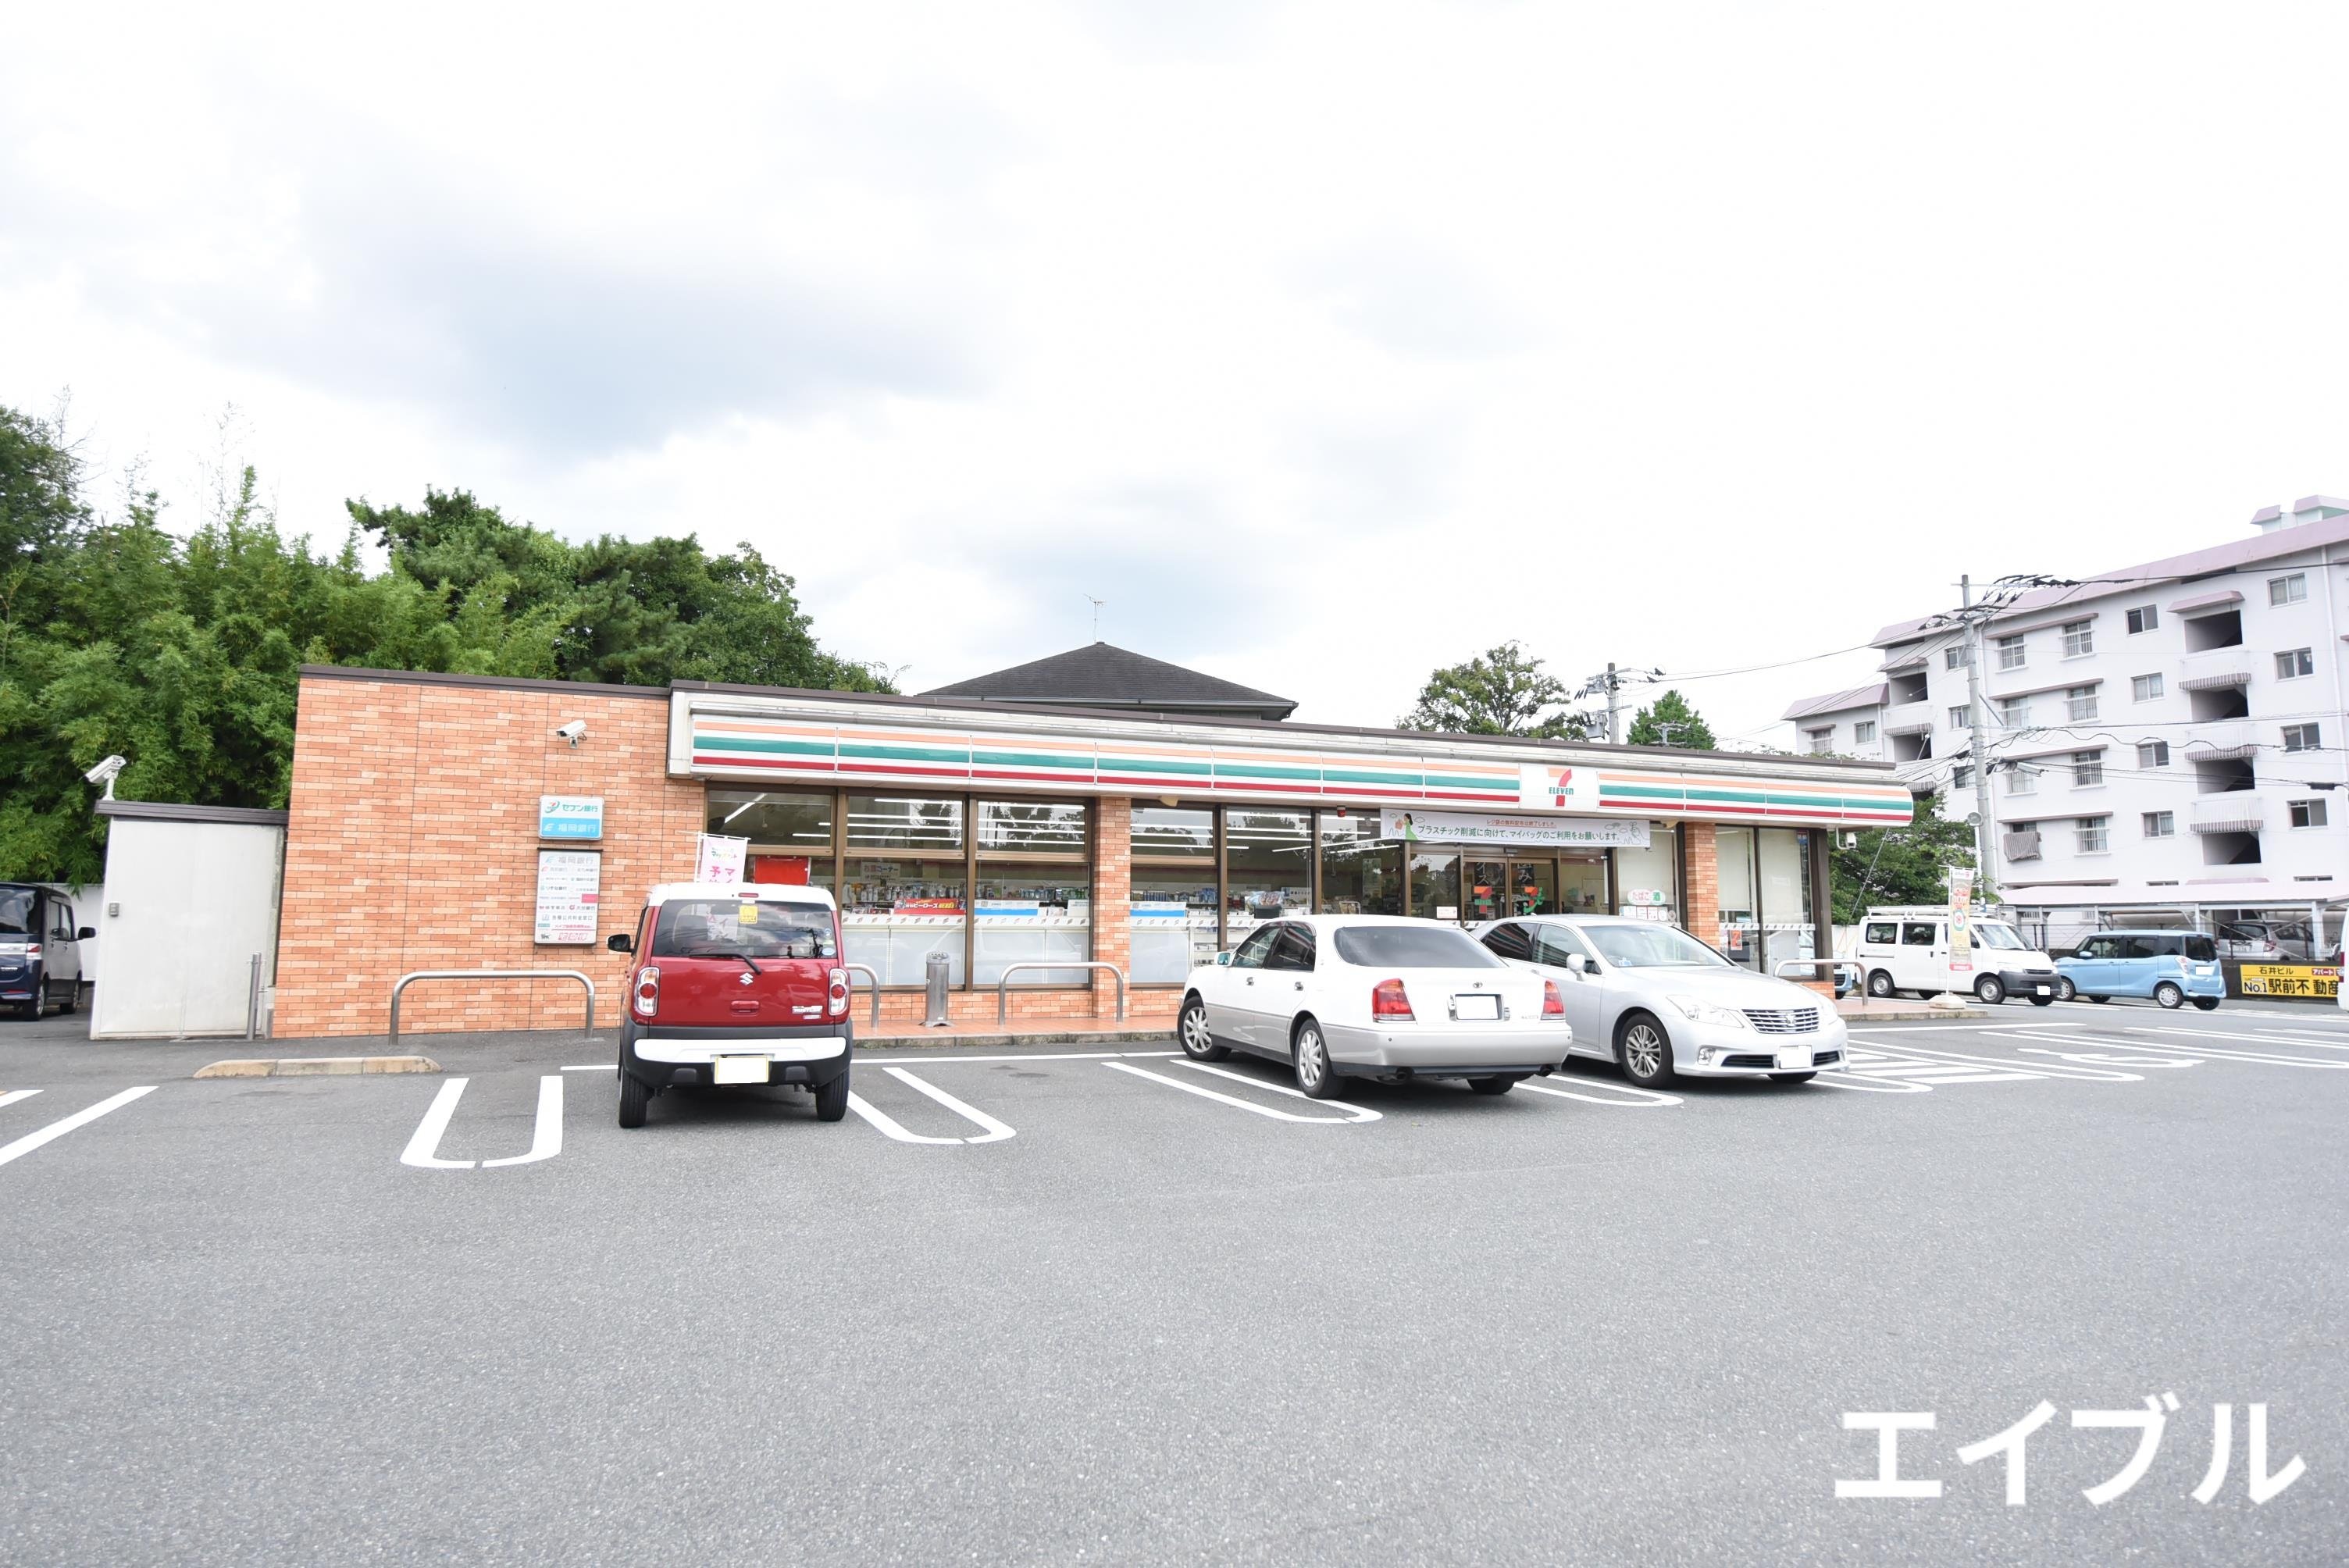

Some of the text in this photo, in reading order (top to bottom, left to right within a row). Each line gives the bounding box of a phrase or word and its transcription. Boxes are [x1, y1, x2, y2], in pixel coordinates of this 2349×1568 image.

[2259, 966, 2294, 975] 石井ビル
[2243, 982, 2268, 993] No.1
